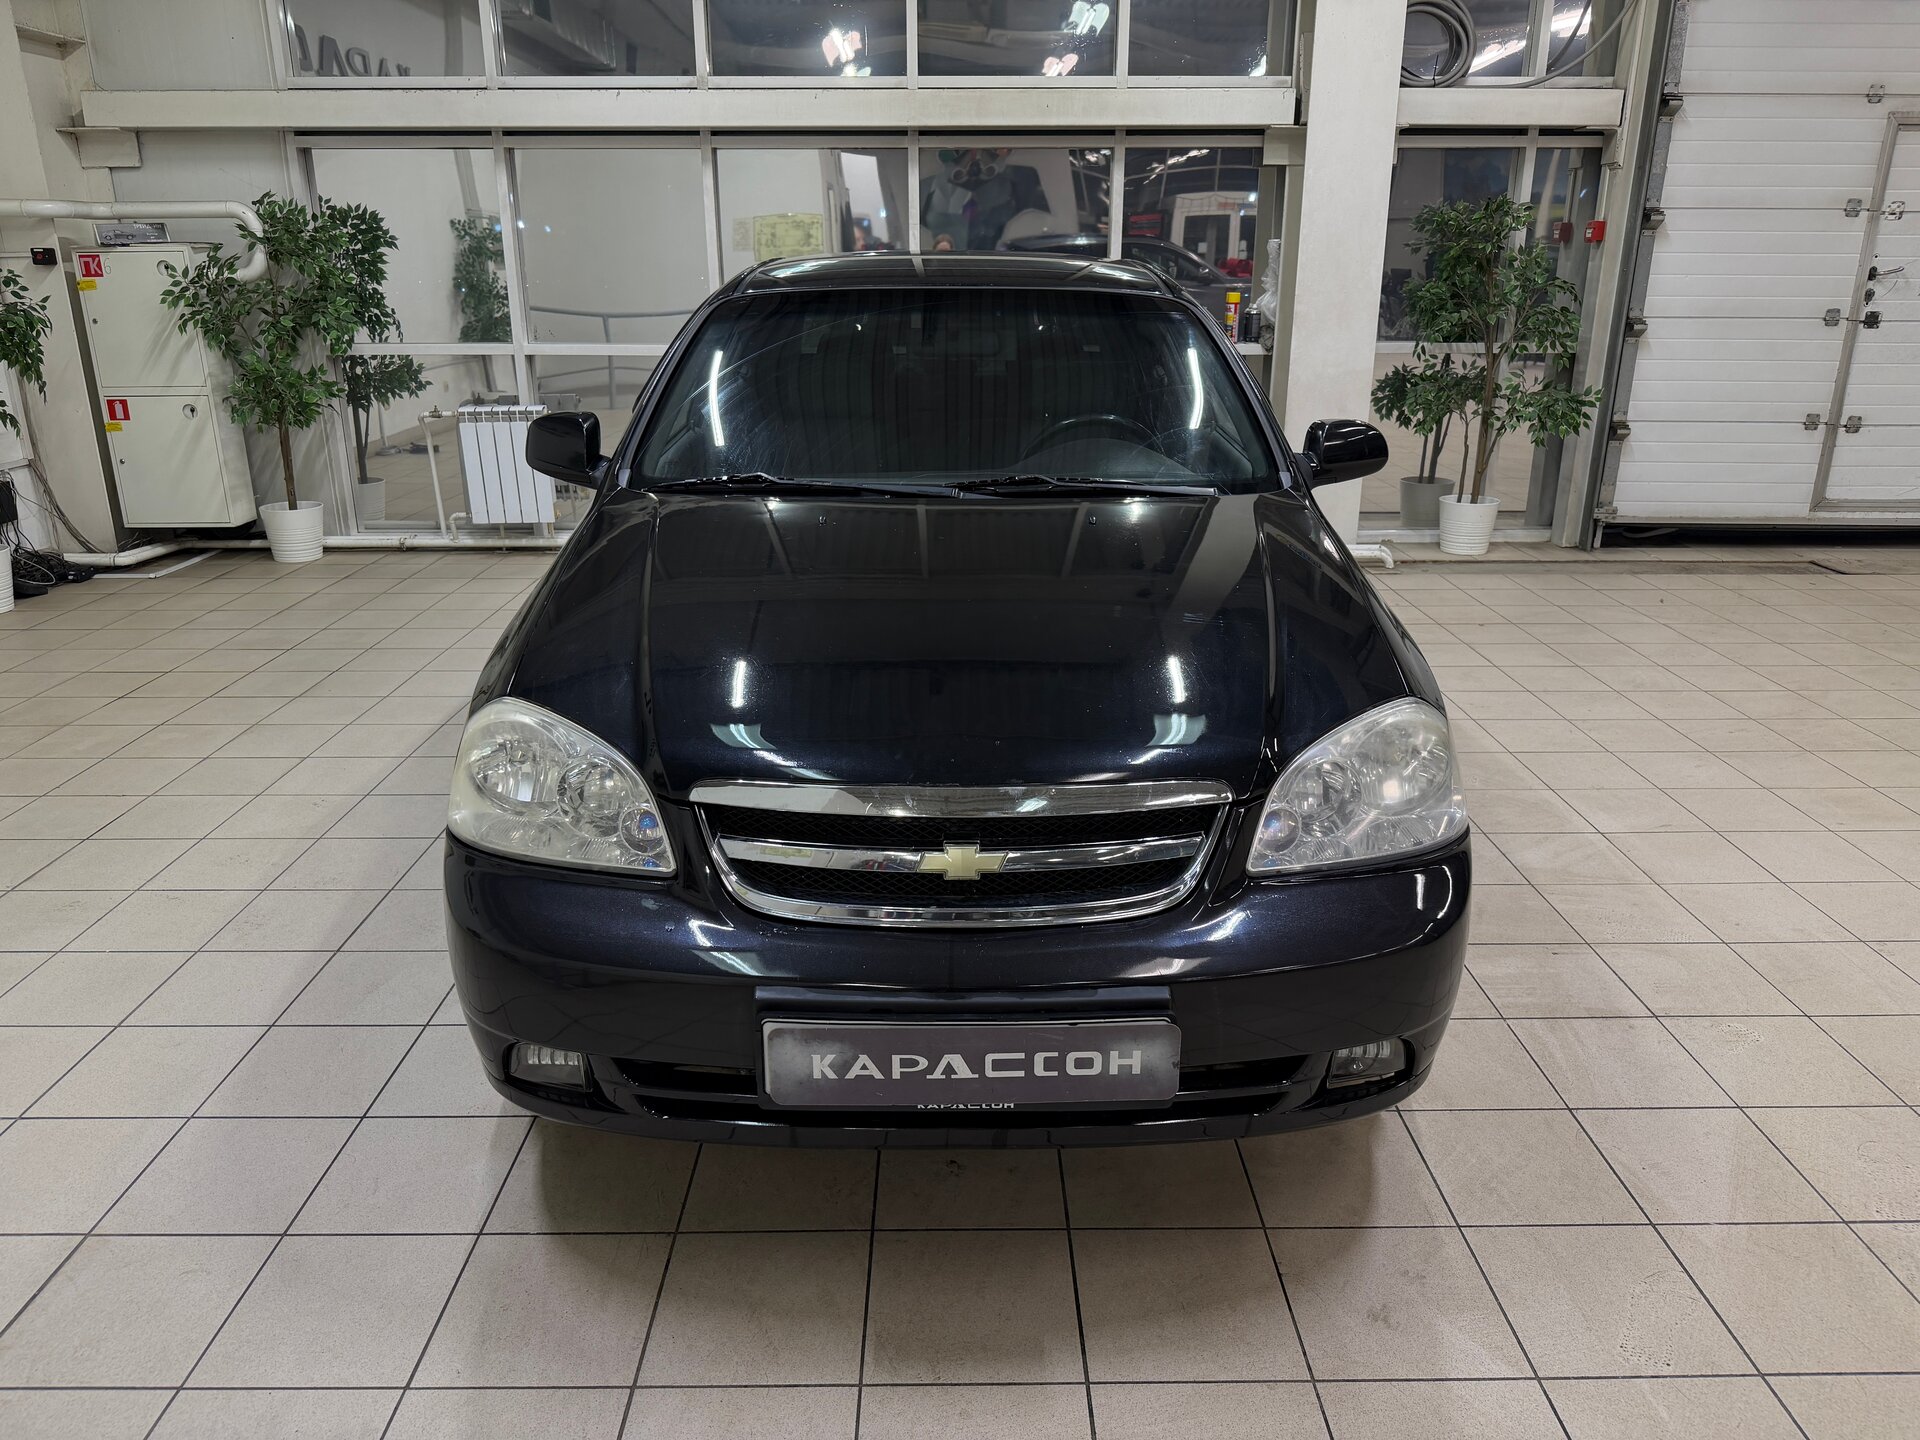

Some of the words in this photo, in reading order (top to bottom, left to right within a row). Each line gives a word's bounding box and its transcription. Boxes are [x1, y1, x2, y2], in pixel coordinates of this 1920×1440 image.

[80, 257, 102, 275] ПК
[104, 257, 112, 275] 6
[811, 1050, 1142, 1080] КАРАССОН
